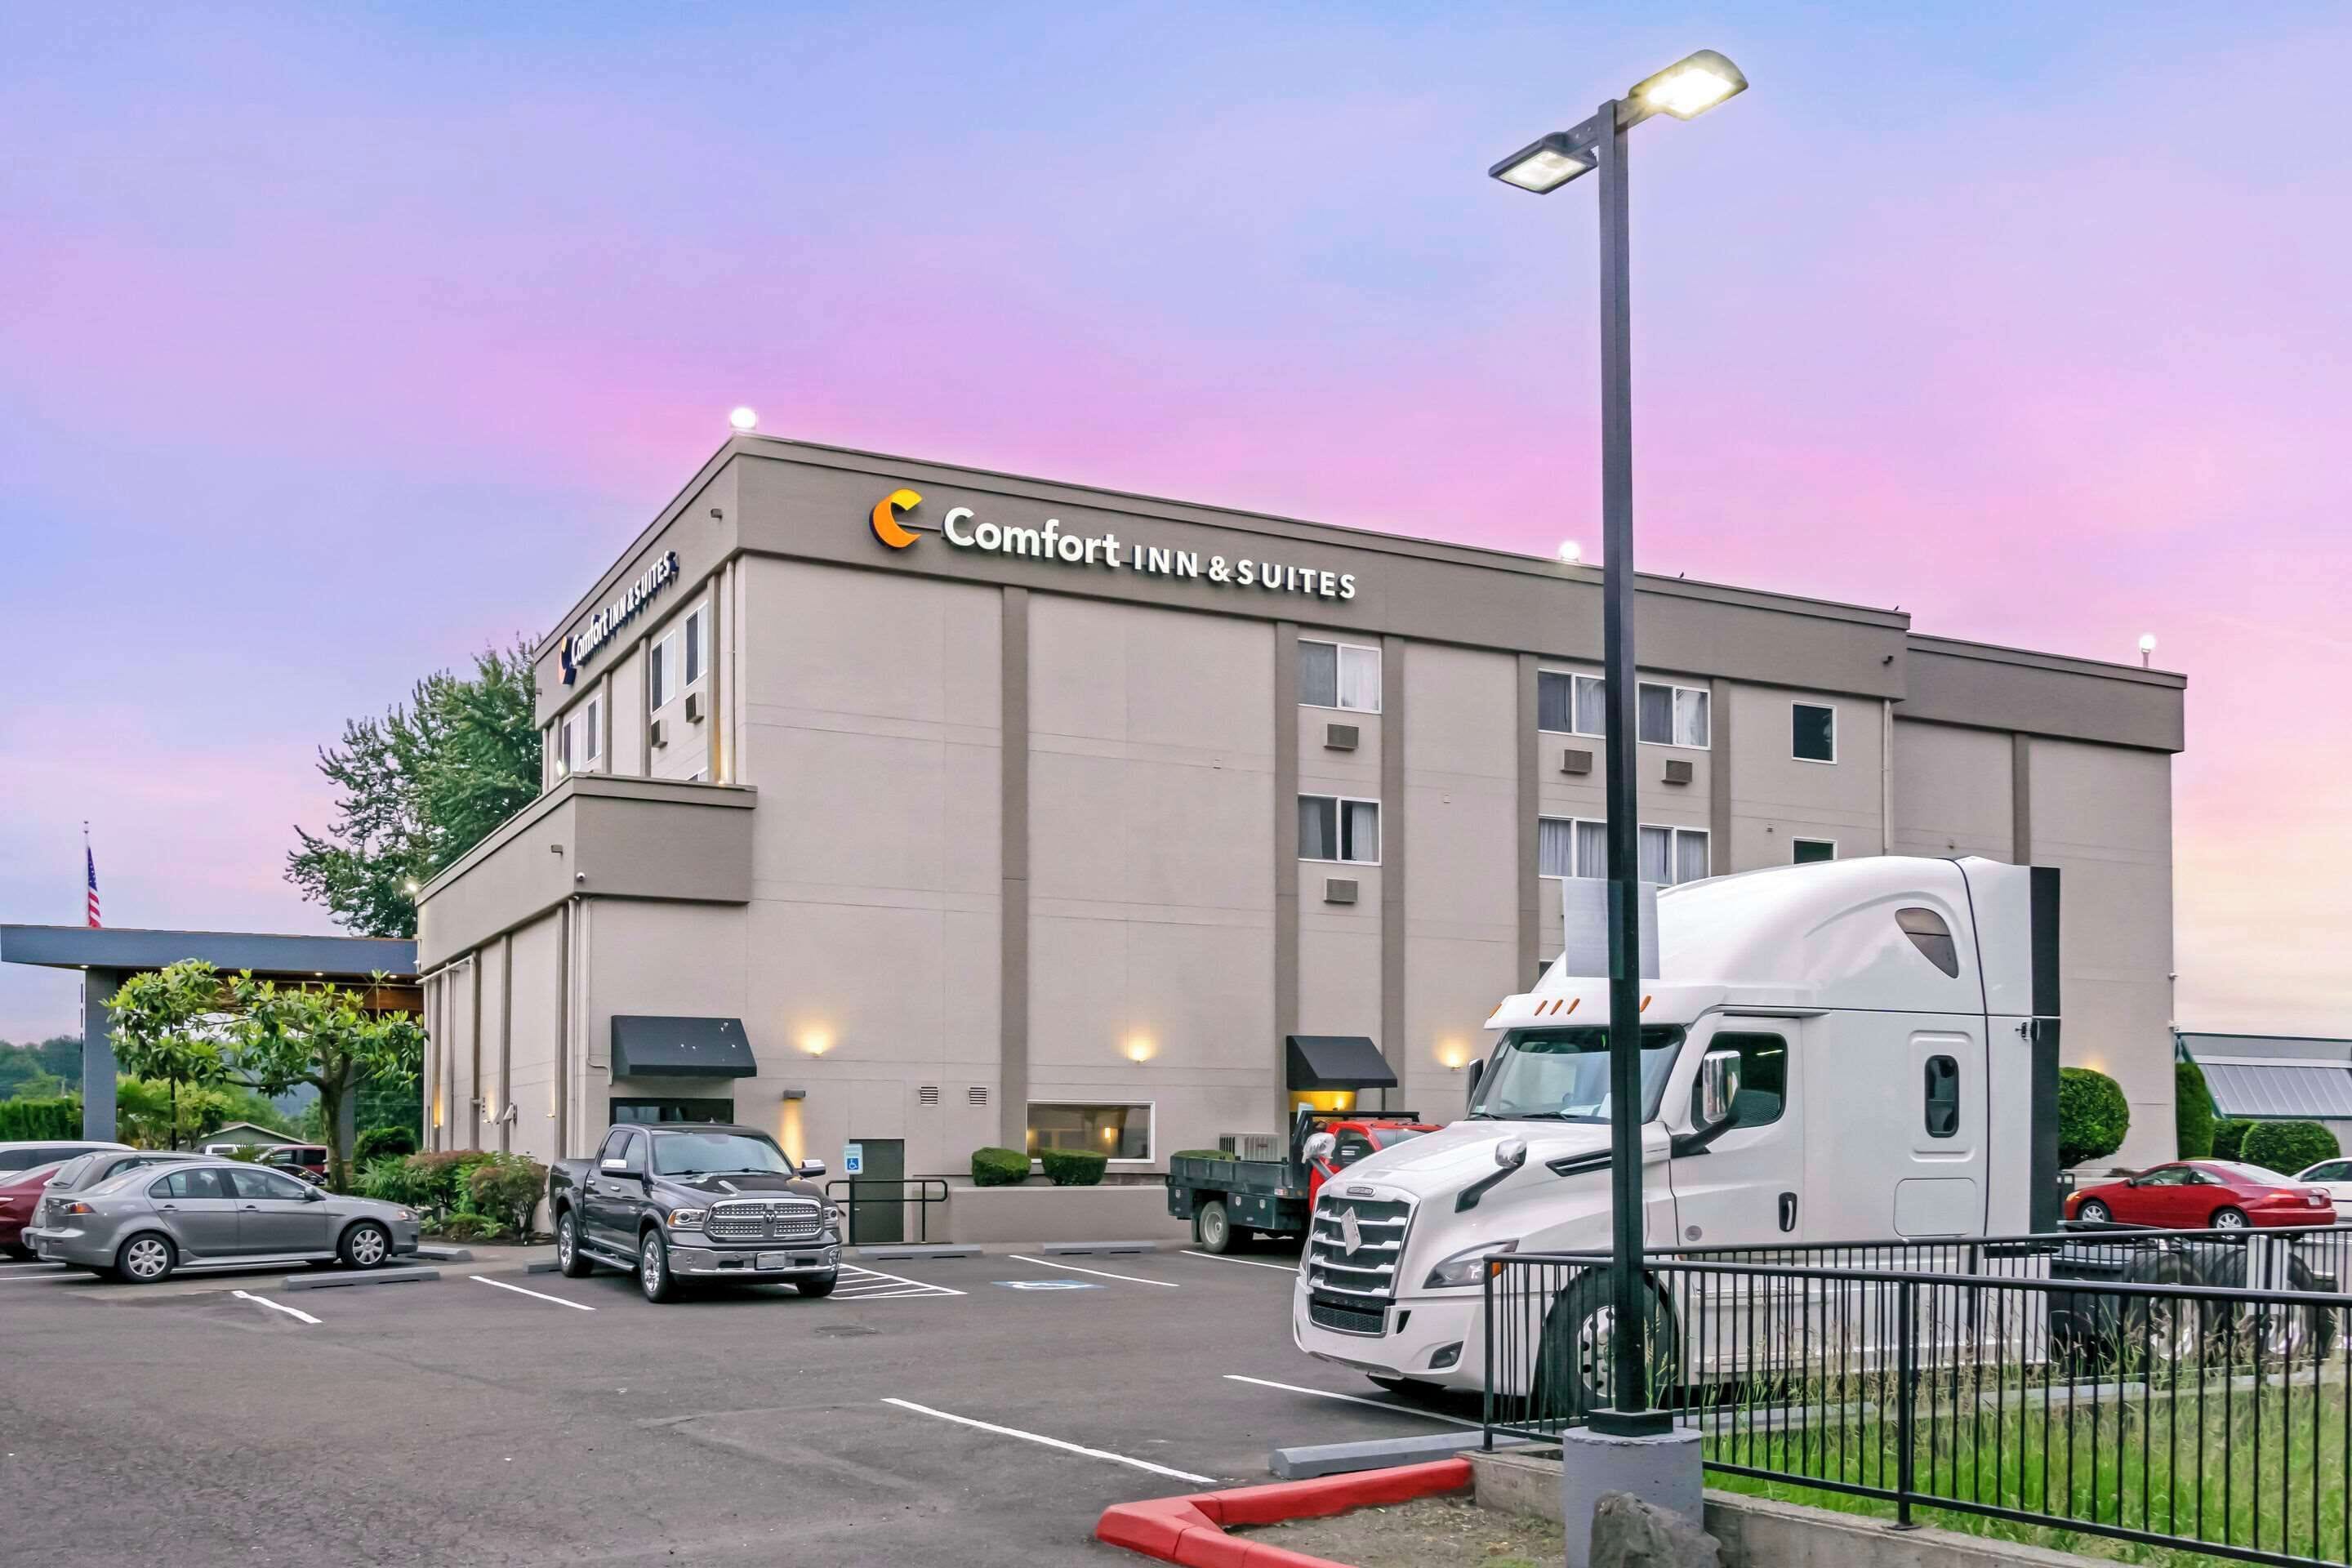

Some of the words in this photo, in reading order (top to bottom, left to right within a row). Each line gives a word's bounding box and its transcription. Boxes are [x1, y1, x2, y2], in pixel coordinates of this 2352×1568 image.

[943, 506, 1121, 568] Comfort
[1133, 545, 1198, 577] INN
[572, 608, 608, 666] Comfort
[609, 595, 627, 630] INN
